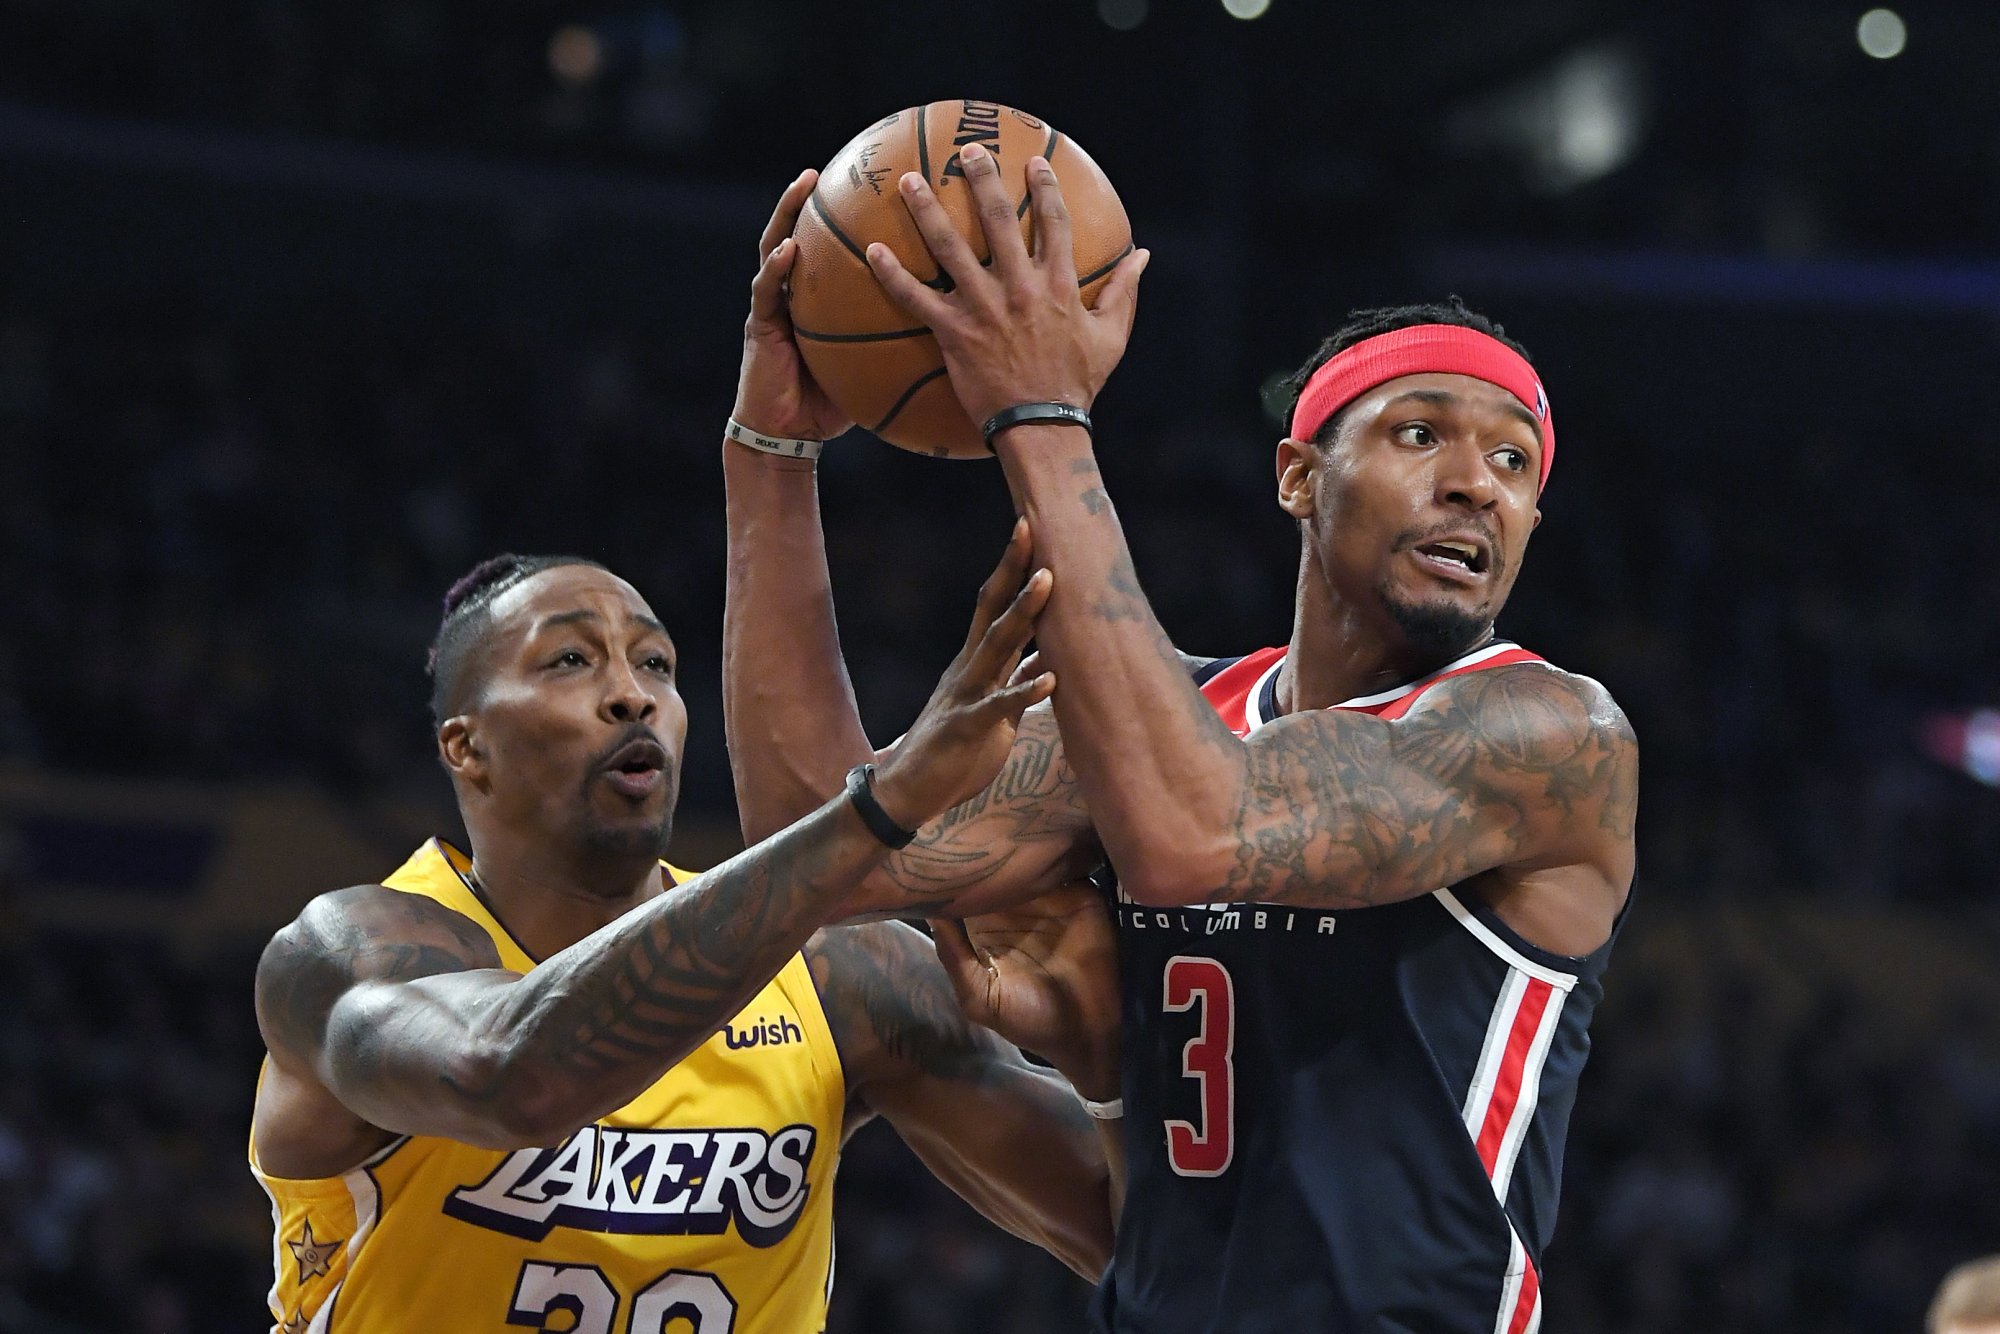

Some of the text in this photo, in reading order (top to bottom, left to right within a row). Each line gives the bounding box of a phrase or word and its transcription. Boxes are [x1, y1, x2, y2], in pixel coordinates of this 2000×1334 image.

[755, 438, 781, 449] DEUCE
[1132, 911, 1337, 935] COLUMBIA
[719, 1015, 802, 1050] wish
[1163, 955, 1235, 1178] 3
[443, 1124, 816, 1247] LAKERS
